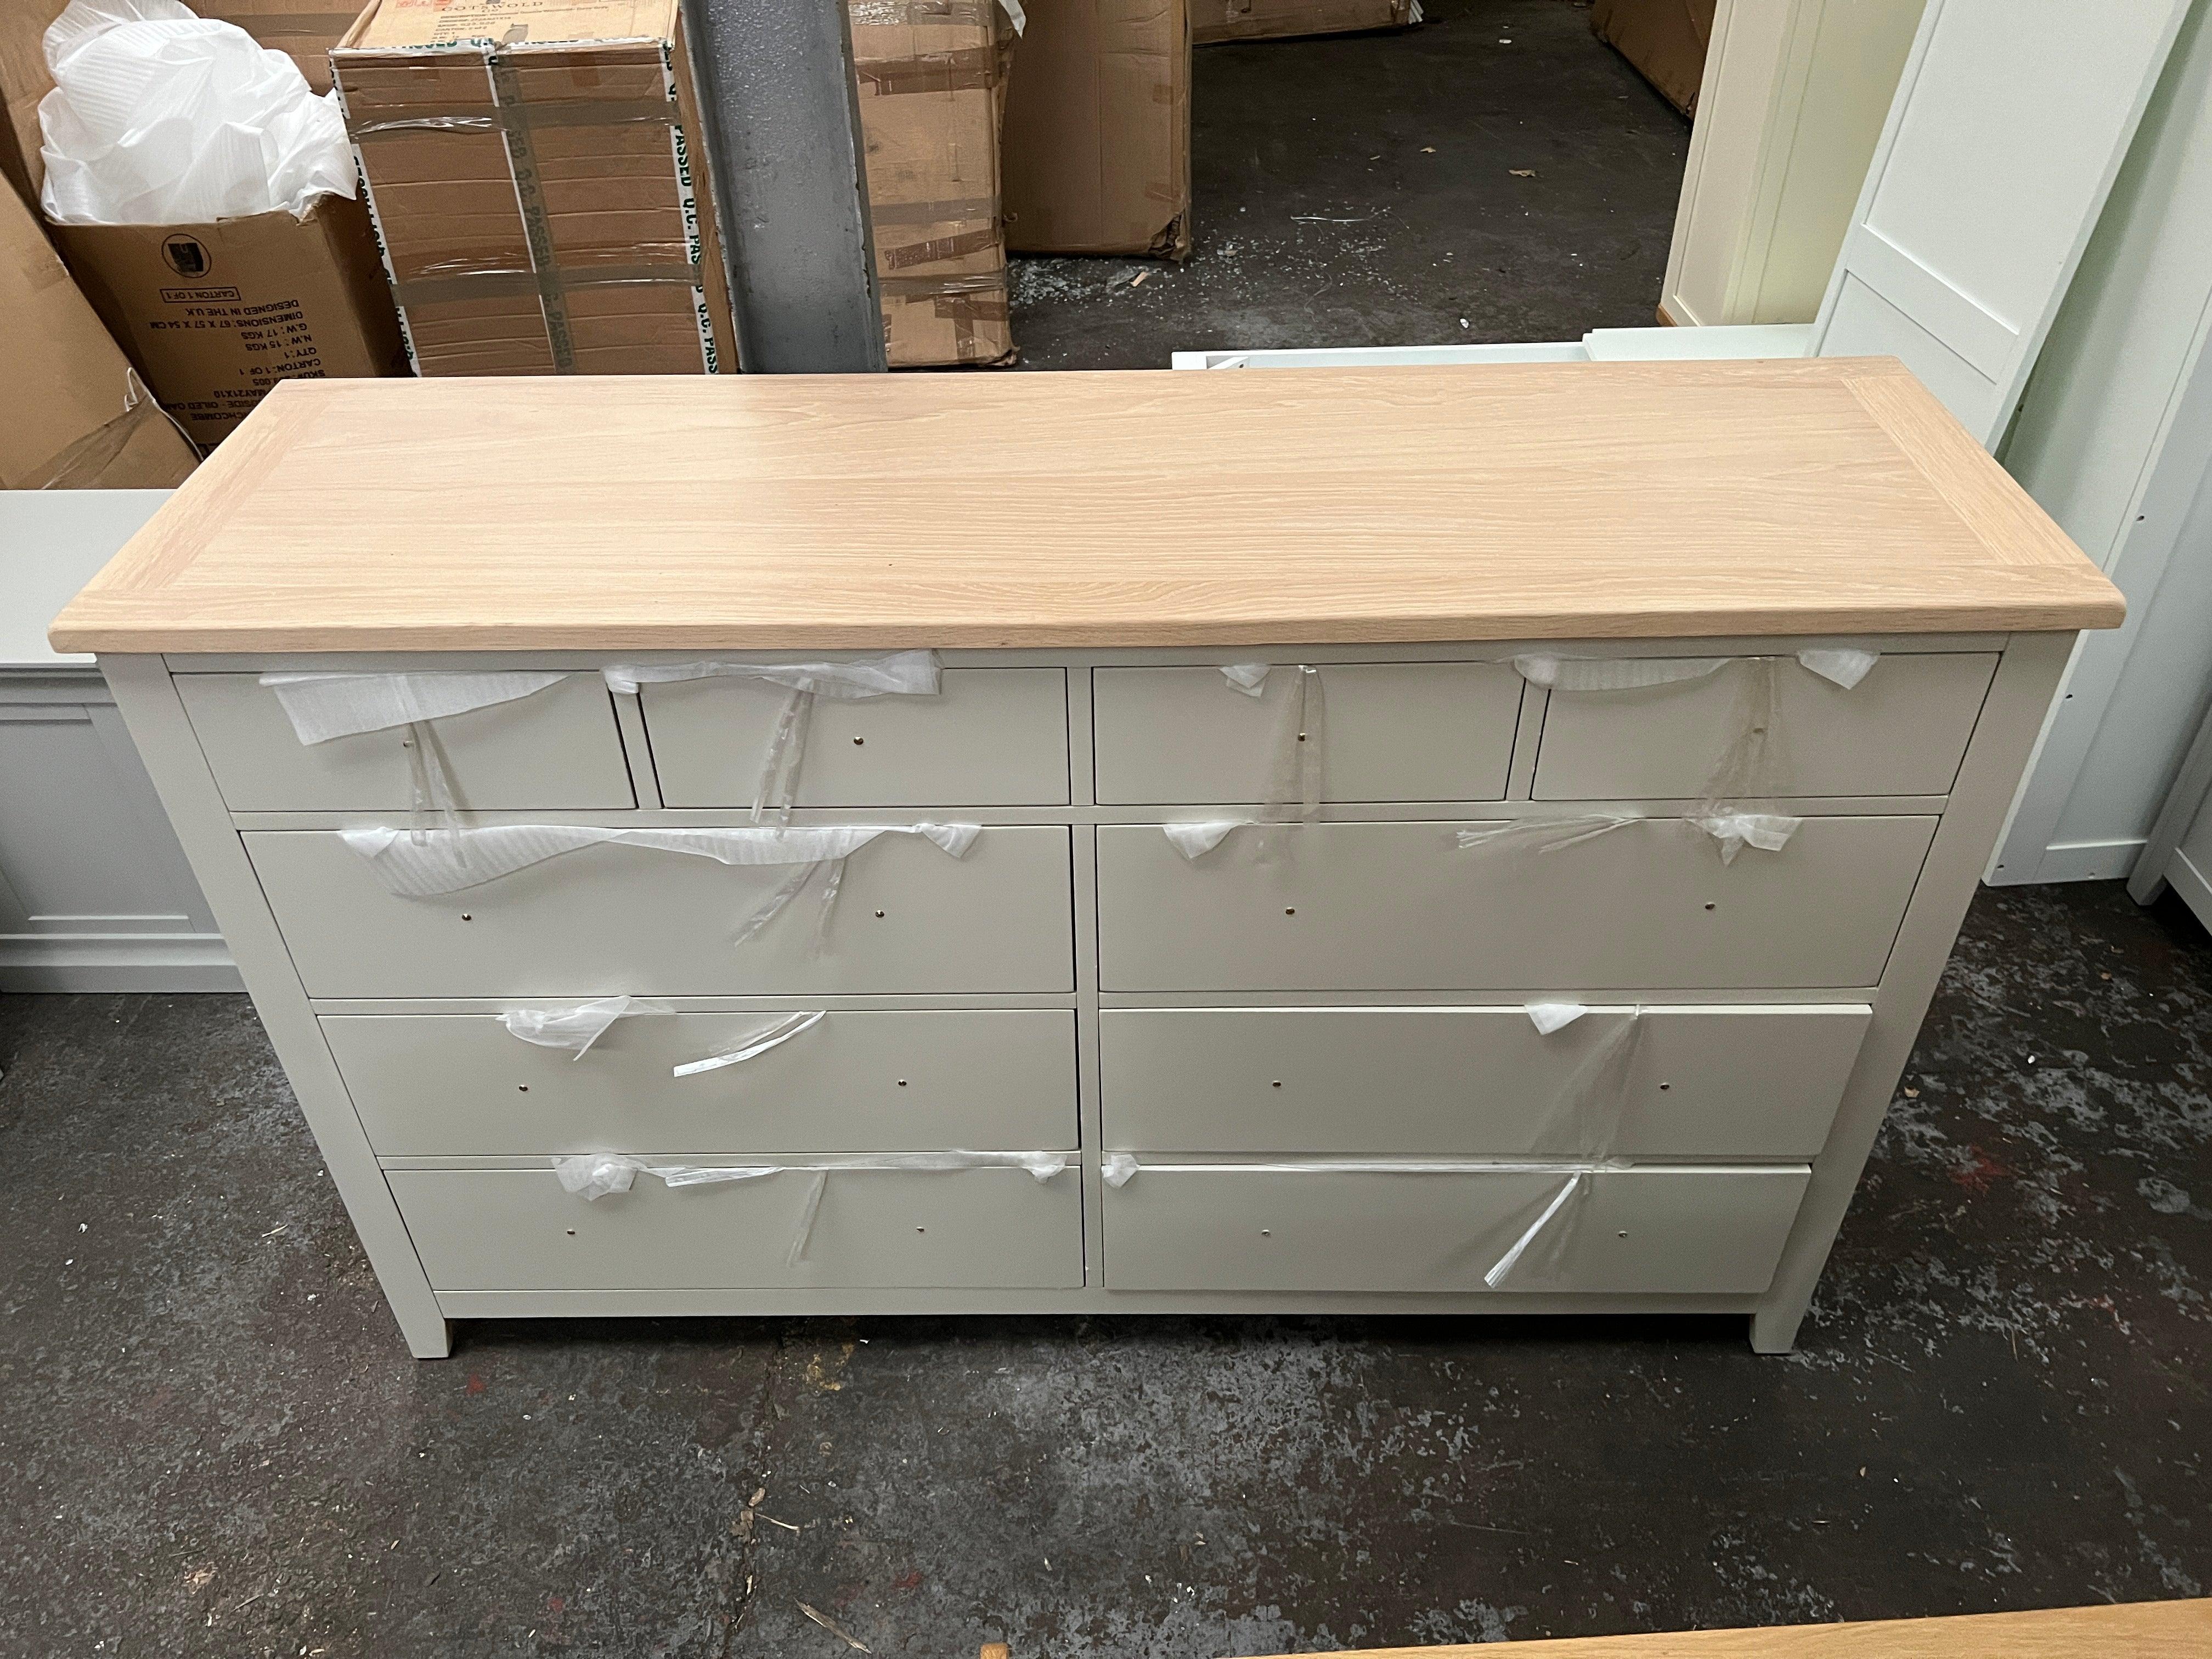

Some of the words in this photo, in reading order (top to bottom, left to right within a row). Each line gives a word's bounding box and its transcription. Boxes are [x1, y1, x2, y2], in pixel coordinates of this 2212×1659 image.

[442, 2, 543, 12] COTSWOLD
[674, 124, 692, 187] PASSED
[682, 198, 697, 229] Q.C.
[174, 291, 186, 300] OF
[195, 290, 234, 298] CARTON
[244, 300, 299, 315] DESIGNED
[233, 311, 303, 328] DIMENSIONS:
[698, 303, 711, 333] Q.C.
[220, 320, 231, 328] 67
[241, 331, 264, 340] KGS
[267, 329, 278, 337] 17
[245, 343, 268, 351] KGS
[269, 340, 281, 348] 15
[191, 412, 247, 421] CHCOMBE
